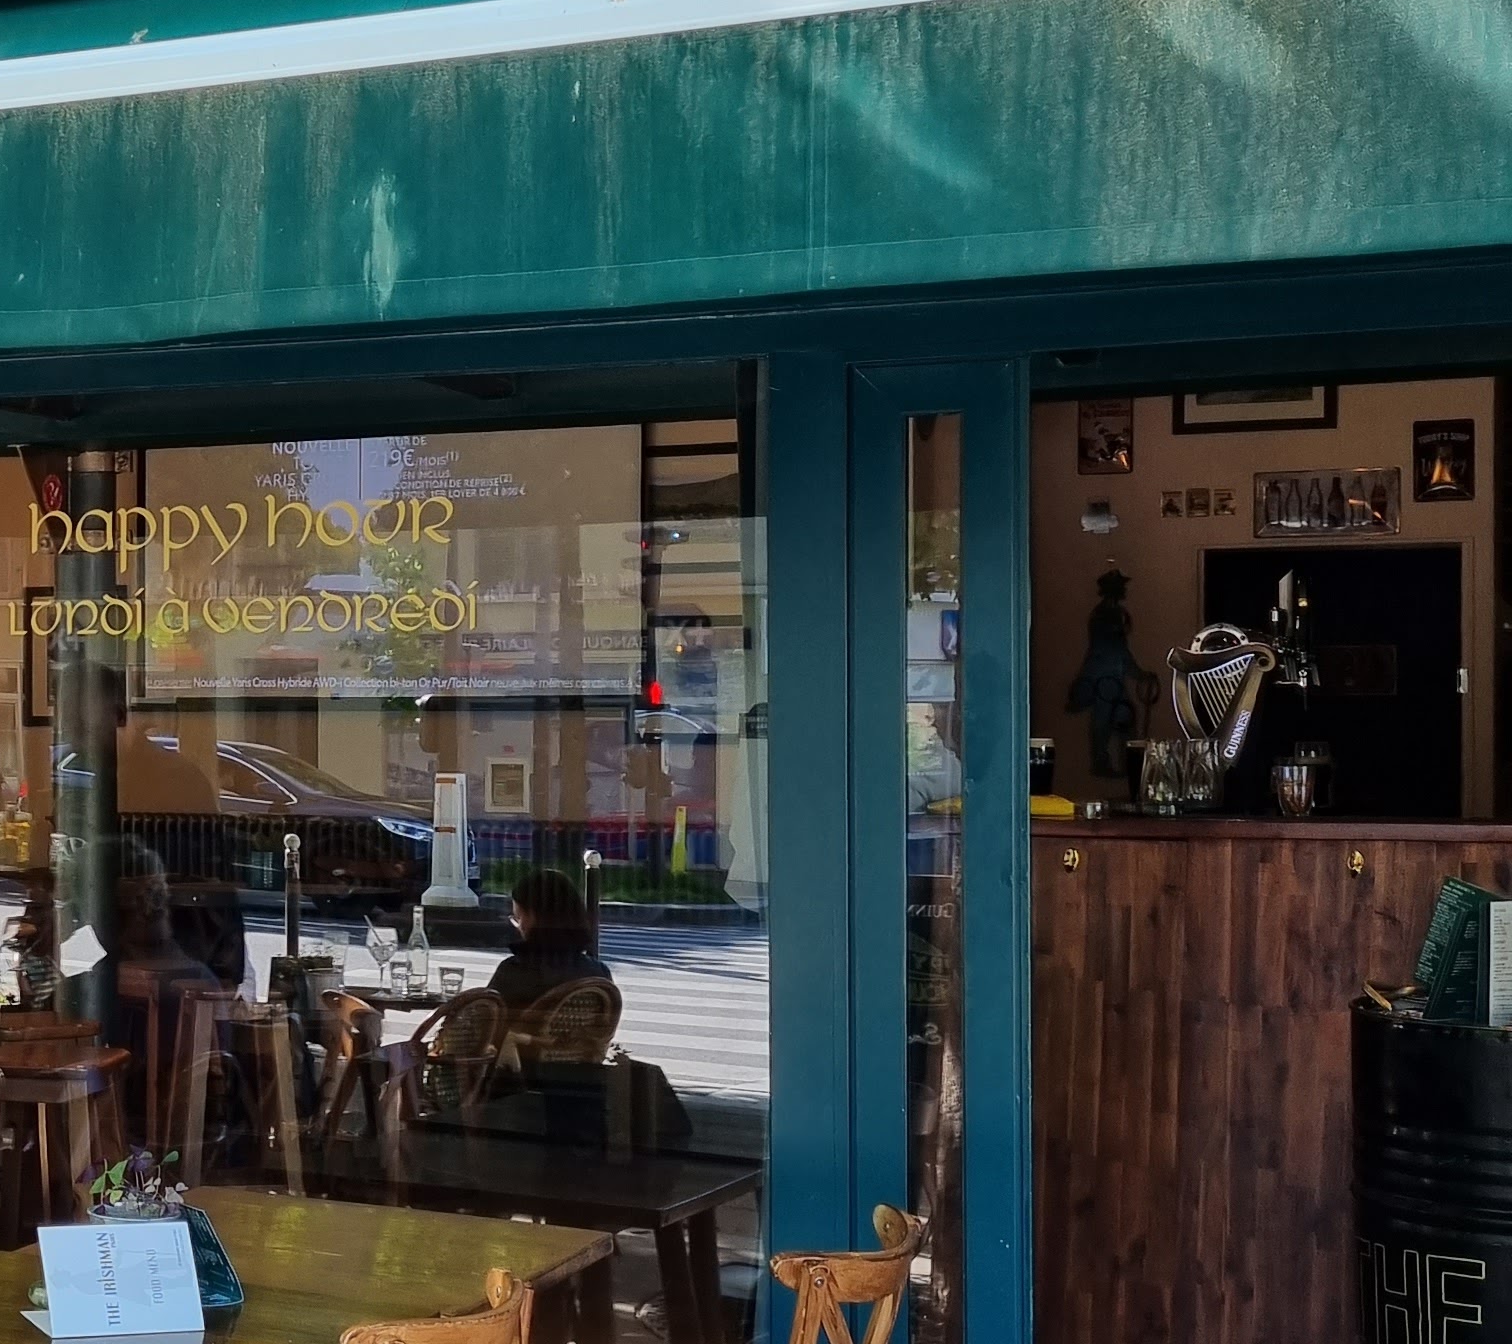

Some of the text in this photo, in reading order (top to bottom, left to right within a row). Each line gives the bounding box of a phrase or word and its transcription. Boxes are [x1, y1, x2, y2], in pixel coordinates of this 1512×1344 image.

[27, 500, 248, 574] happy
[1223, 709, 1251, 758] GUINNESS
[95, 1231, 121, 1327] THE IRISHMAN
[150, 1279, 165, 1304] FOOD
